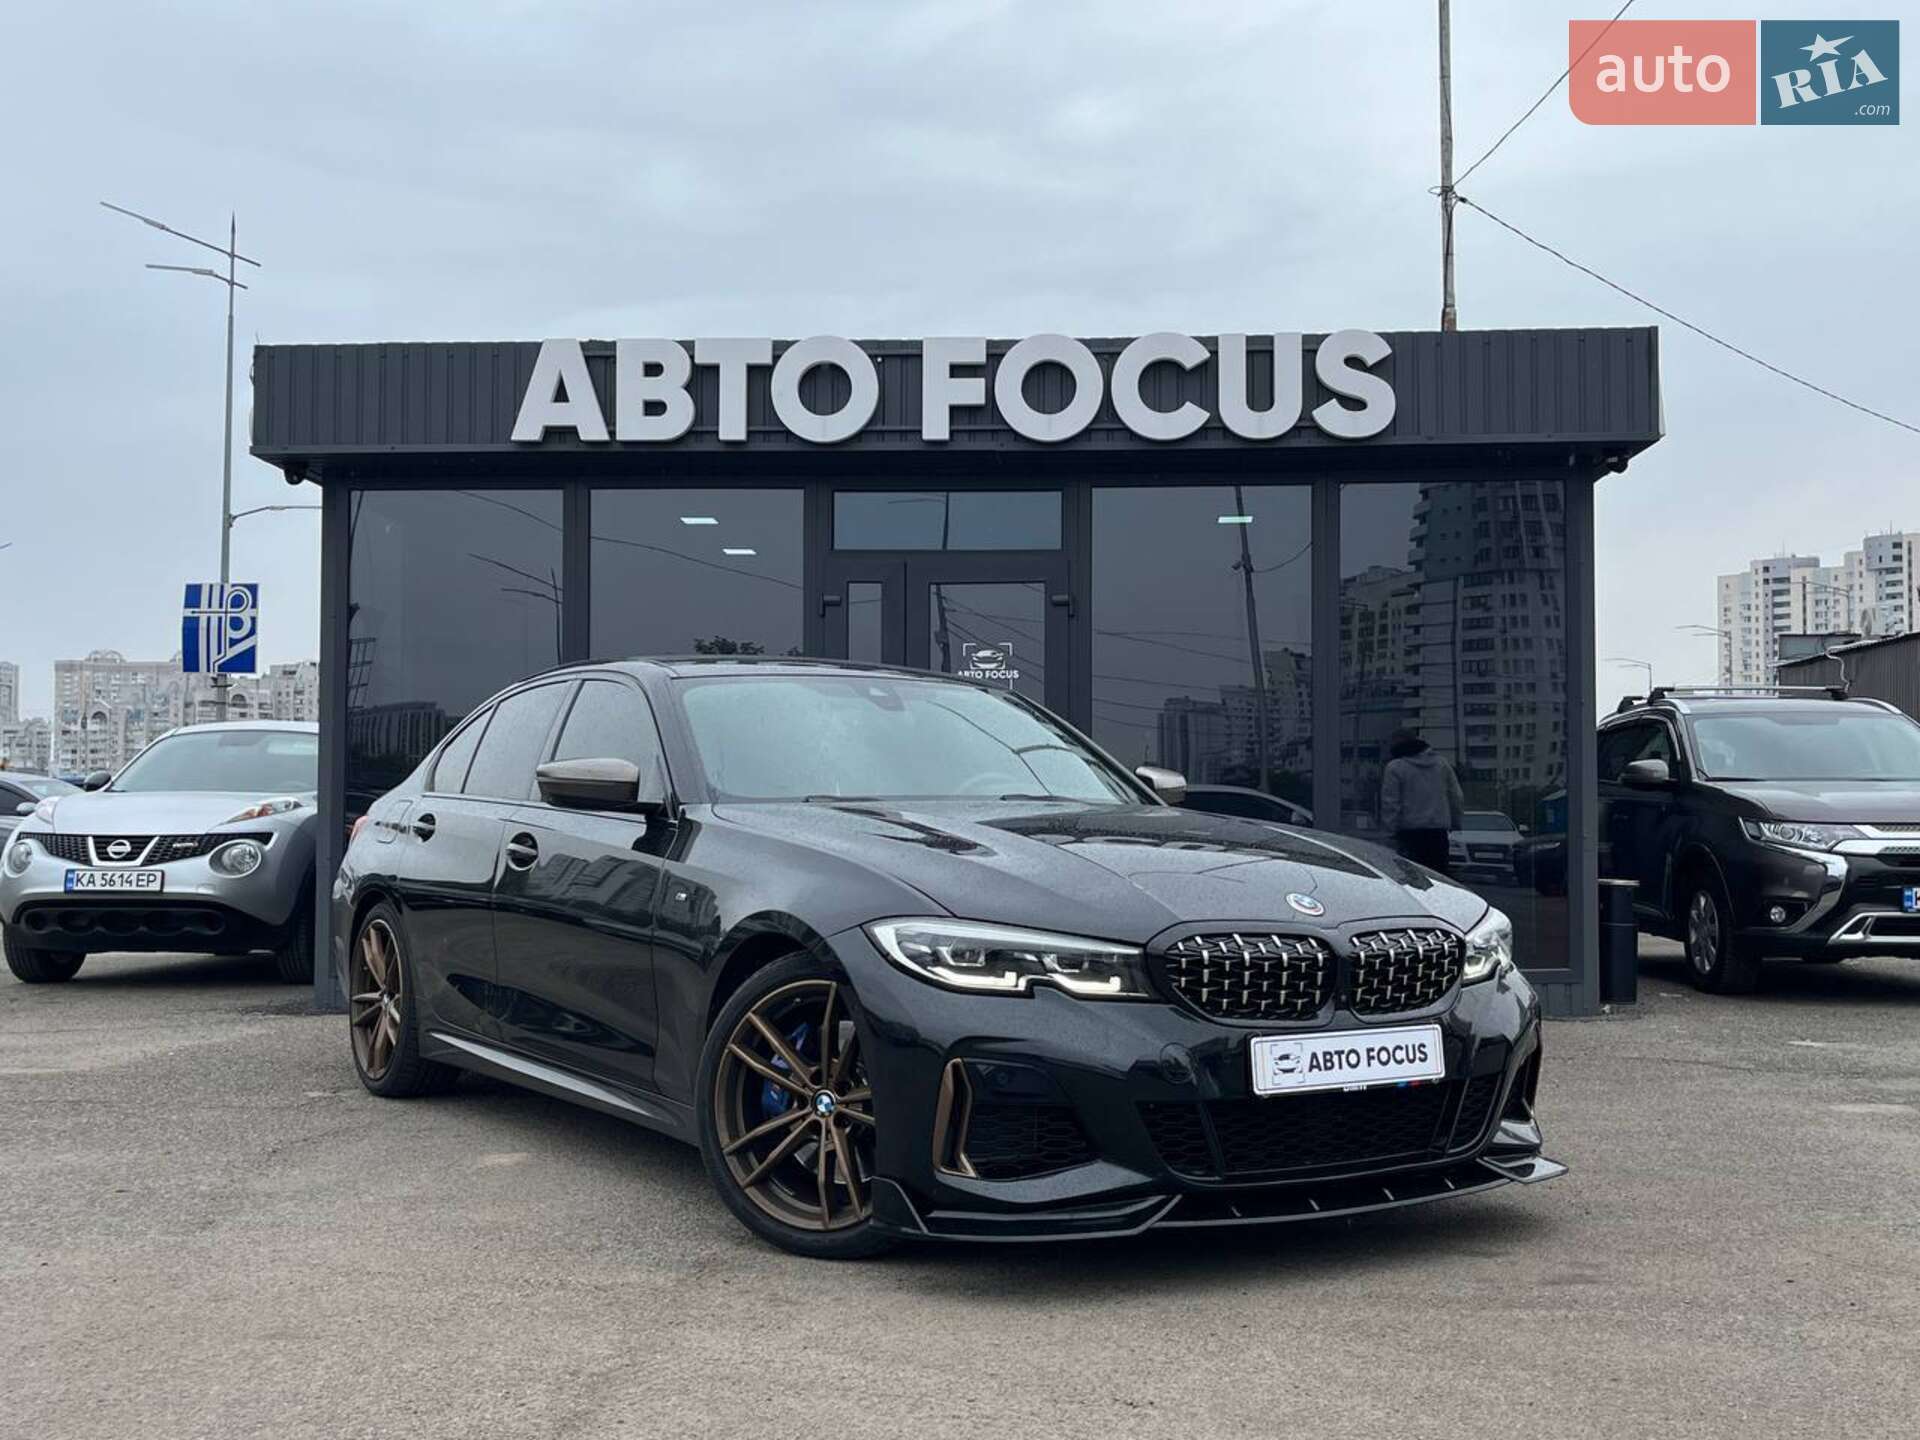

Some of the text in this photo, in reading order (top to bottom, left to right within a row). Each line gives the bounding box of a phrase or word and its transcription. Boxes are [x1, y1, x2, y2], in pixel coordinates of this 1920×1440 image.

[510, 329, 1397, 444] АВТО FOCUS
[985, 670, 1020, 679] FOCUS
[75, 873, 158, 888] KA 5614 EP
[1308, 1043, 1429, 1073] АВТО FOCUS
